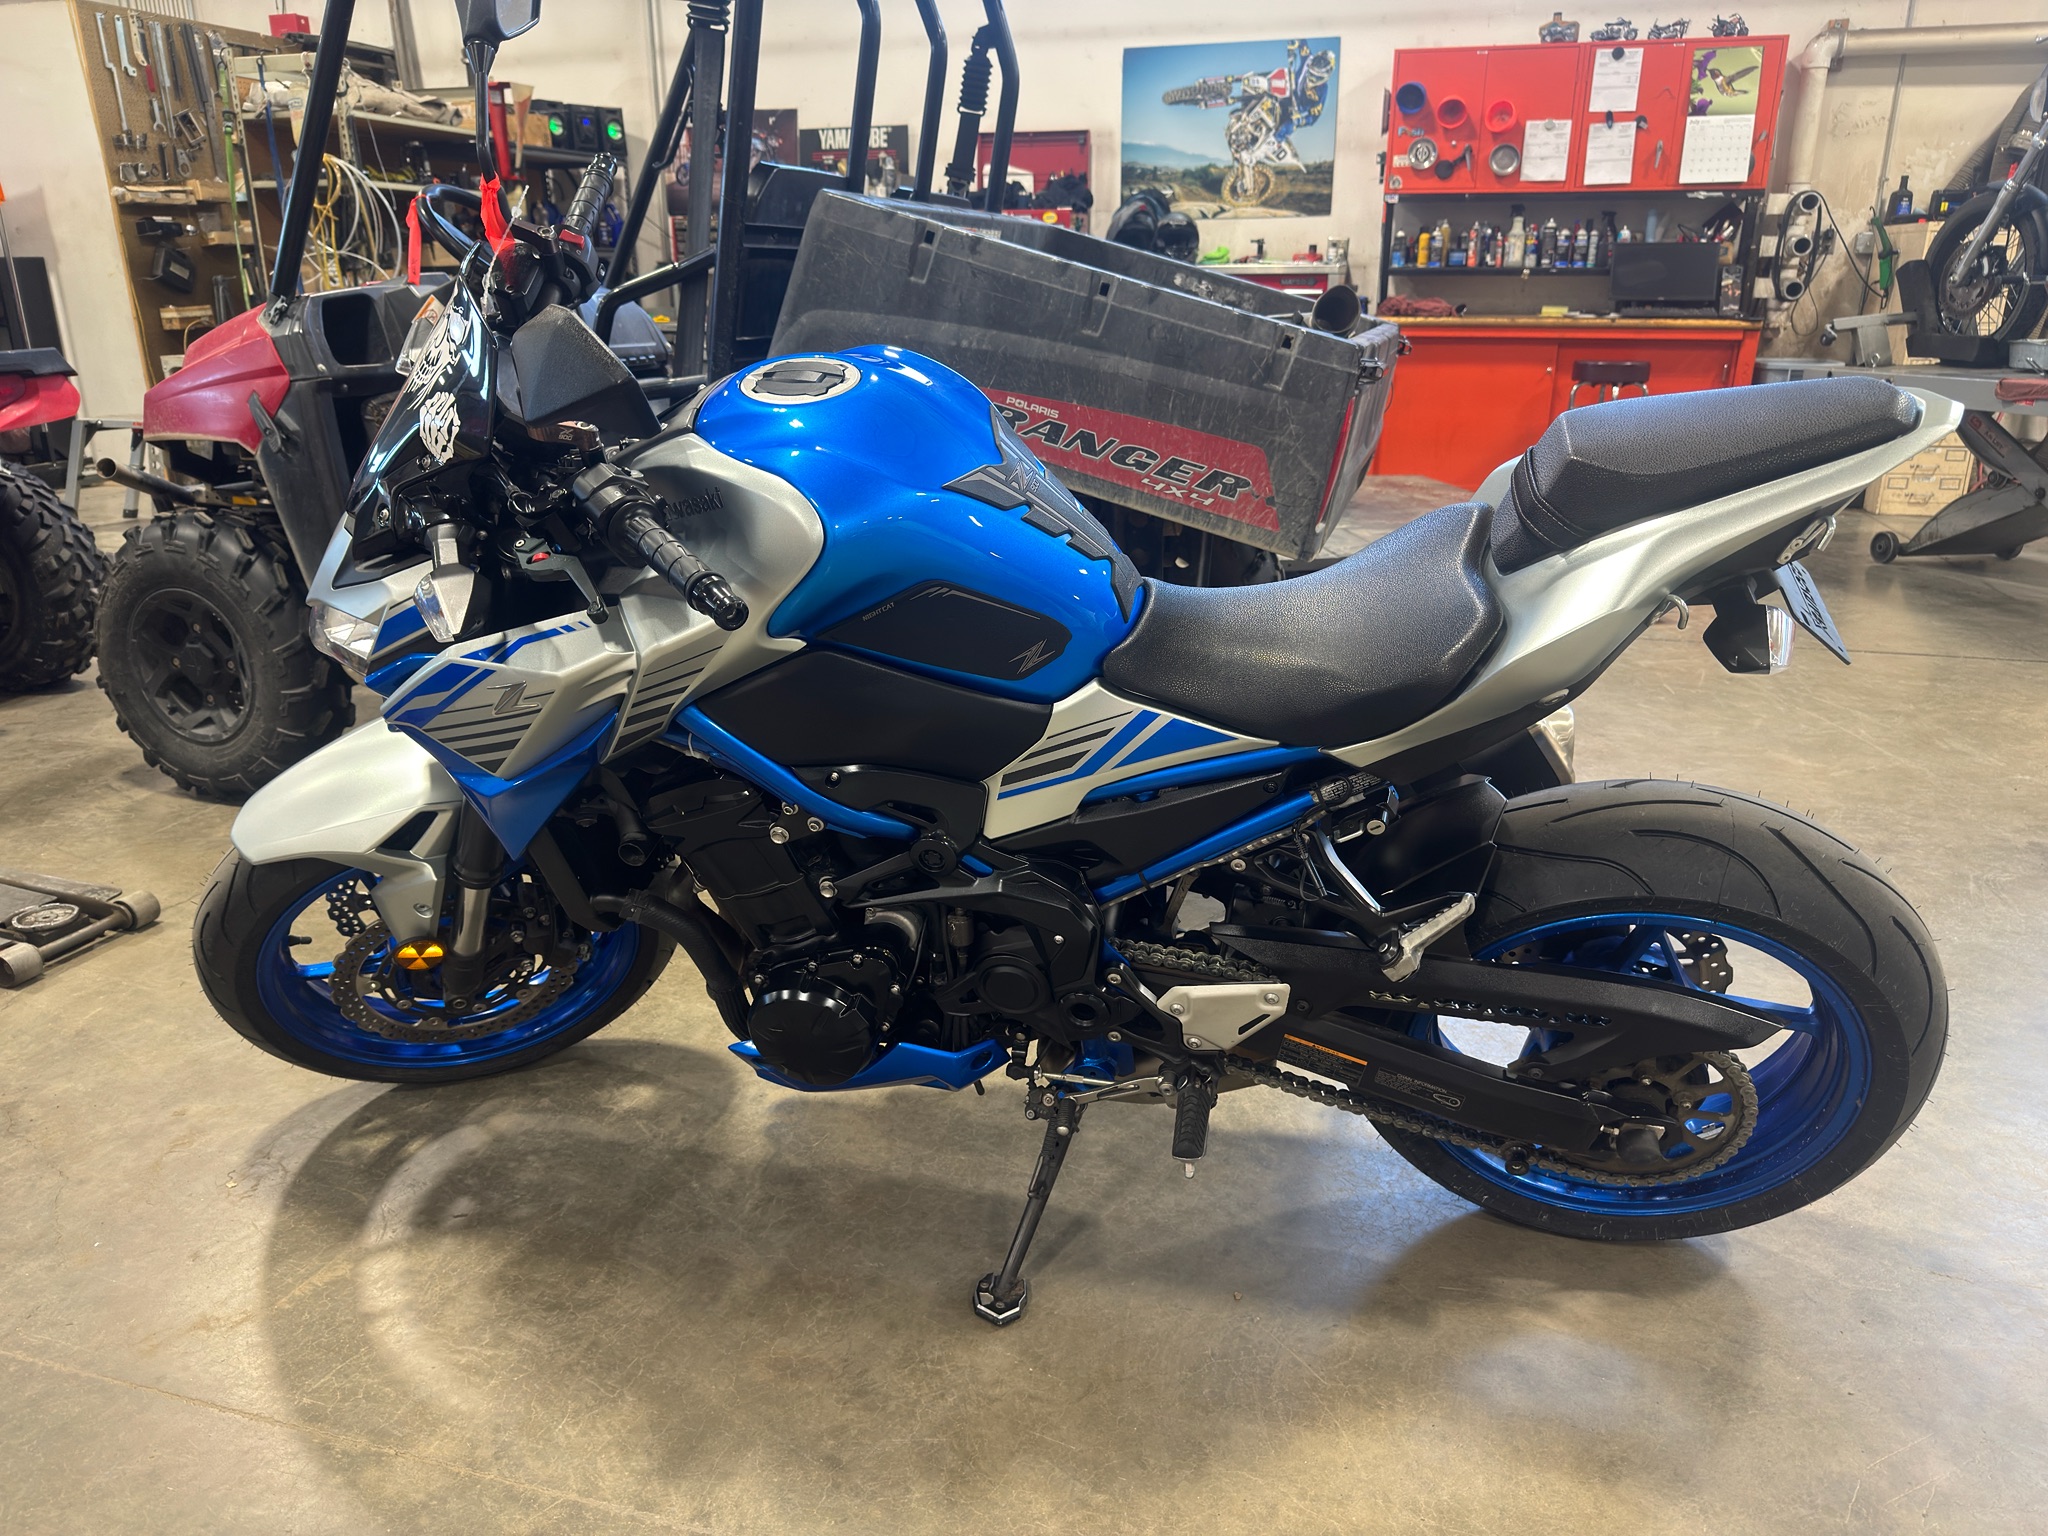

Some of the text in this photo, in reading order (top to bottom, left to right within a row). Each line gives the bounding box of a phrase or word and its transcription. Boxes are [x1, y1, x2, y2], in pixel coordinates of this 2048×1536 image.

[819, 128, 888, 150] YAMBE
[1006, 396, 1060, 419] POLARIS
[993, 402, 1253, 501] RANGER
[666, 486, 724, 520] wasaki
